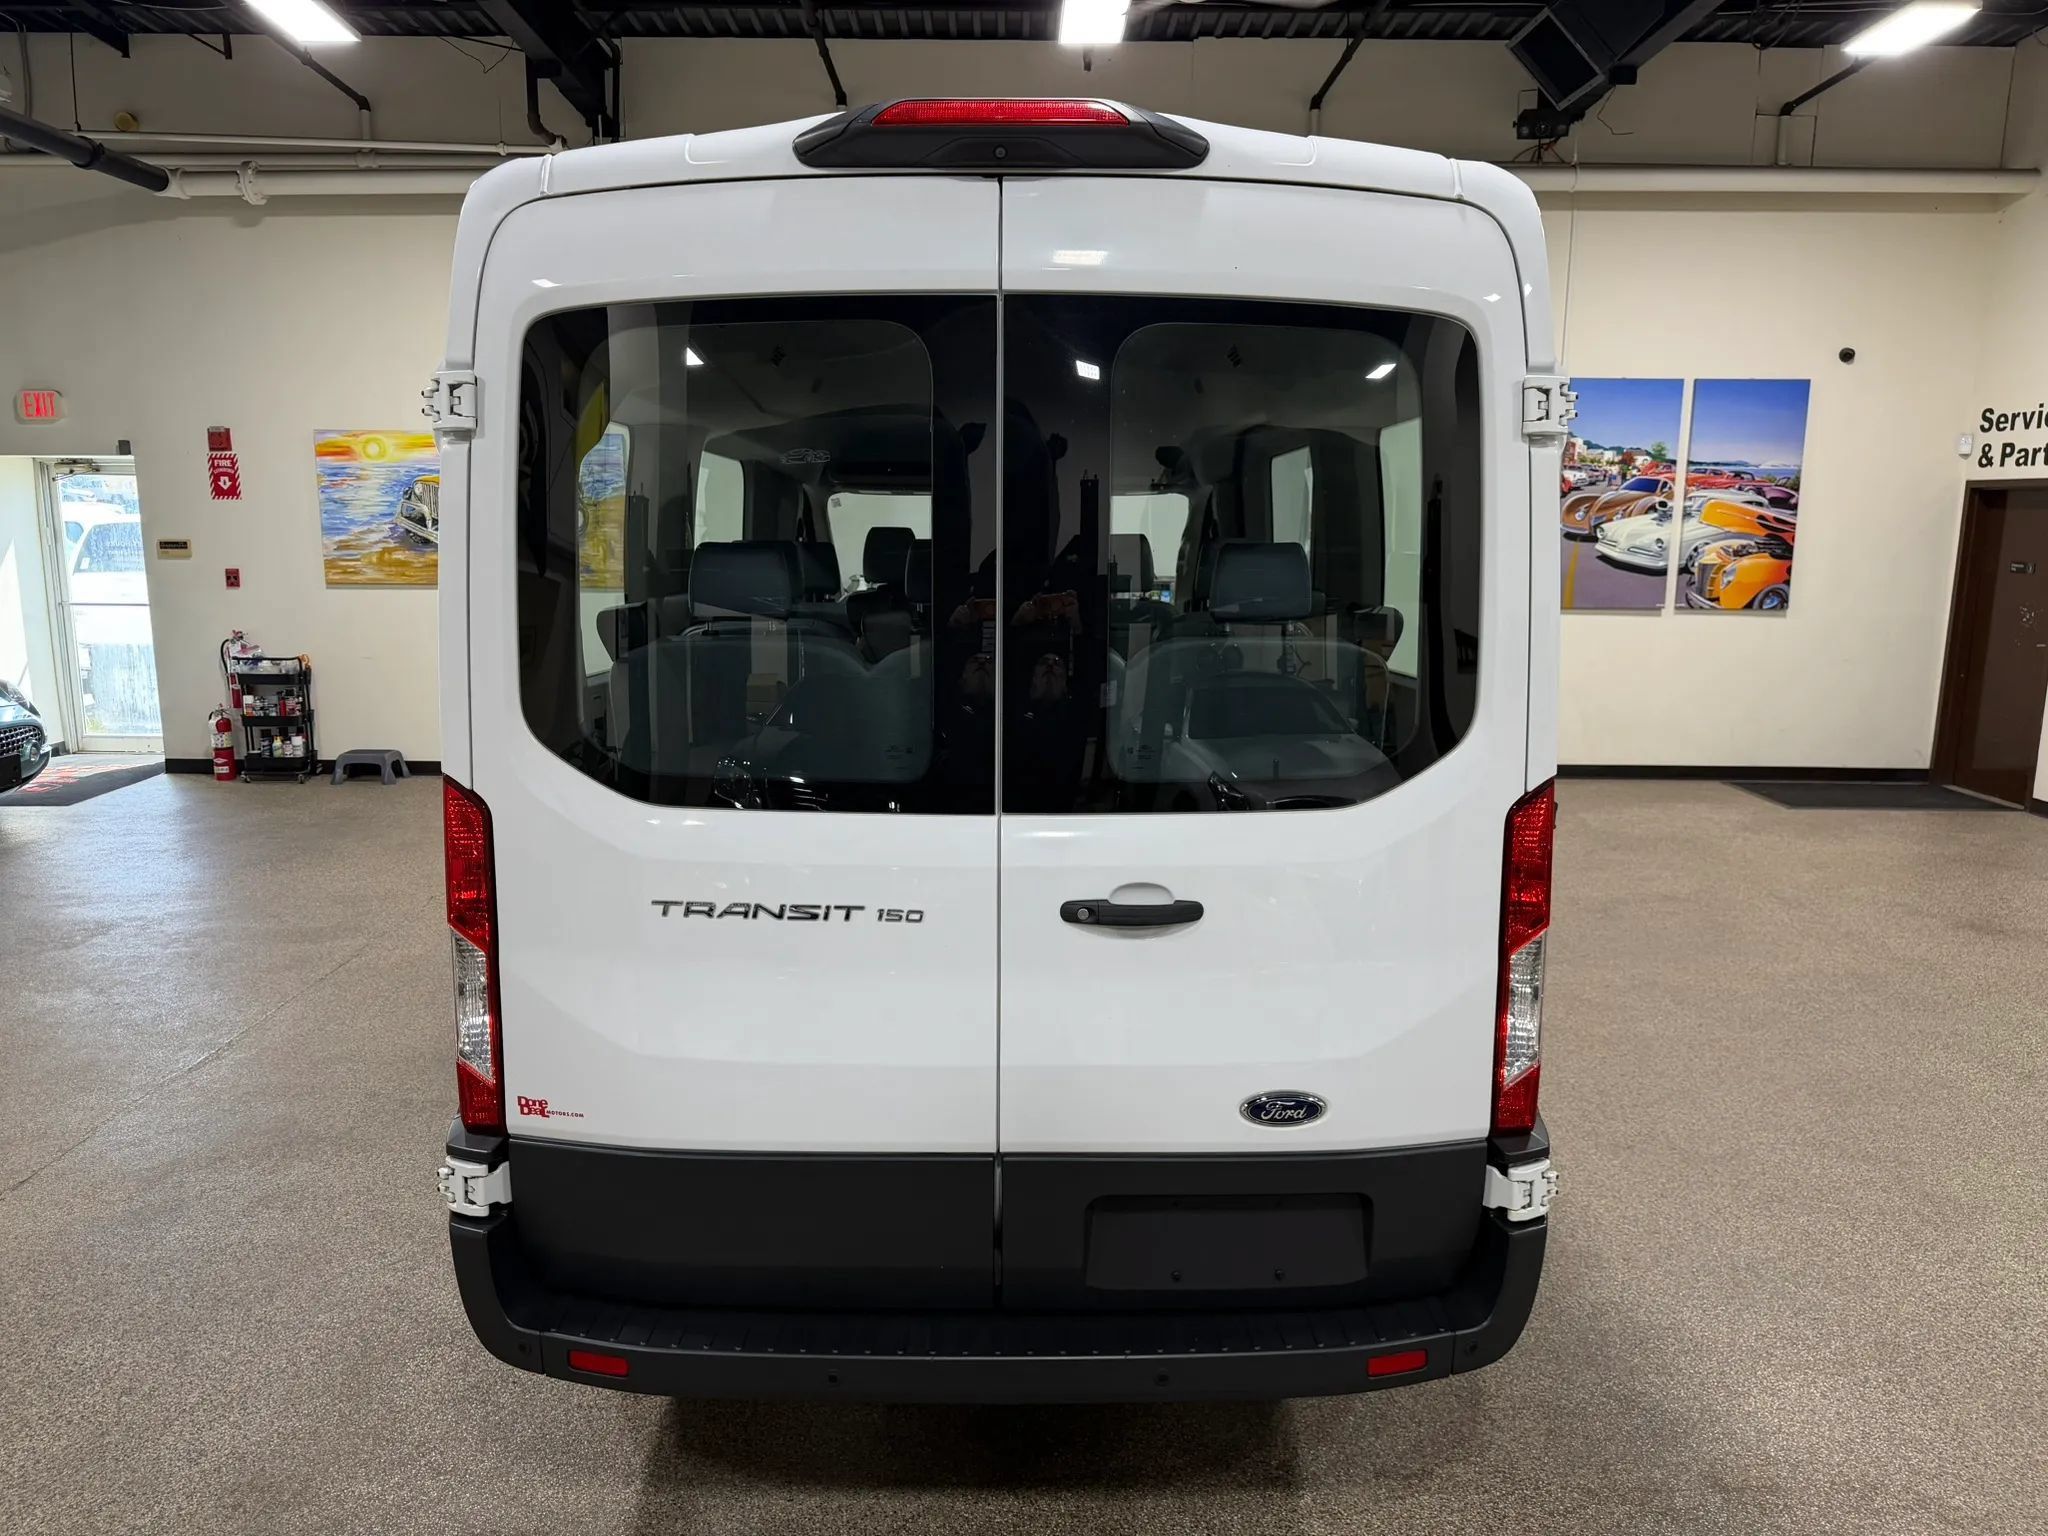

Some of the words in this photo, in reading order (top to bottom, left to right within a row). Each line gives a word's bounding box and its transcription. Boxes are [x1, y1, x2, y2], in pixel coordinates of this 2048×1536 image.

[23, 391, 55, 417] EXIT
[1979, 403, 2048, 433] Servi
[1978, 443, 1994, 468] &
[651, 900, 865, 921] TRANSIT
[876, 908, 924, 923] 150
[517, 1096, 548, 1108] Done
[1261, 1101, 1307, 1119] Ford
[546, 1110, 584, 1118] MOTORS.COM
